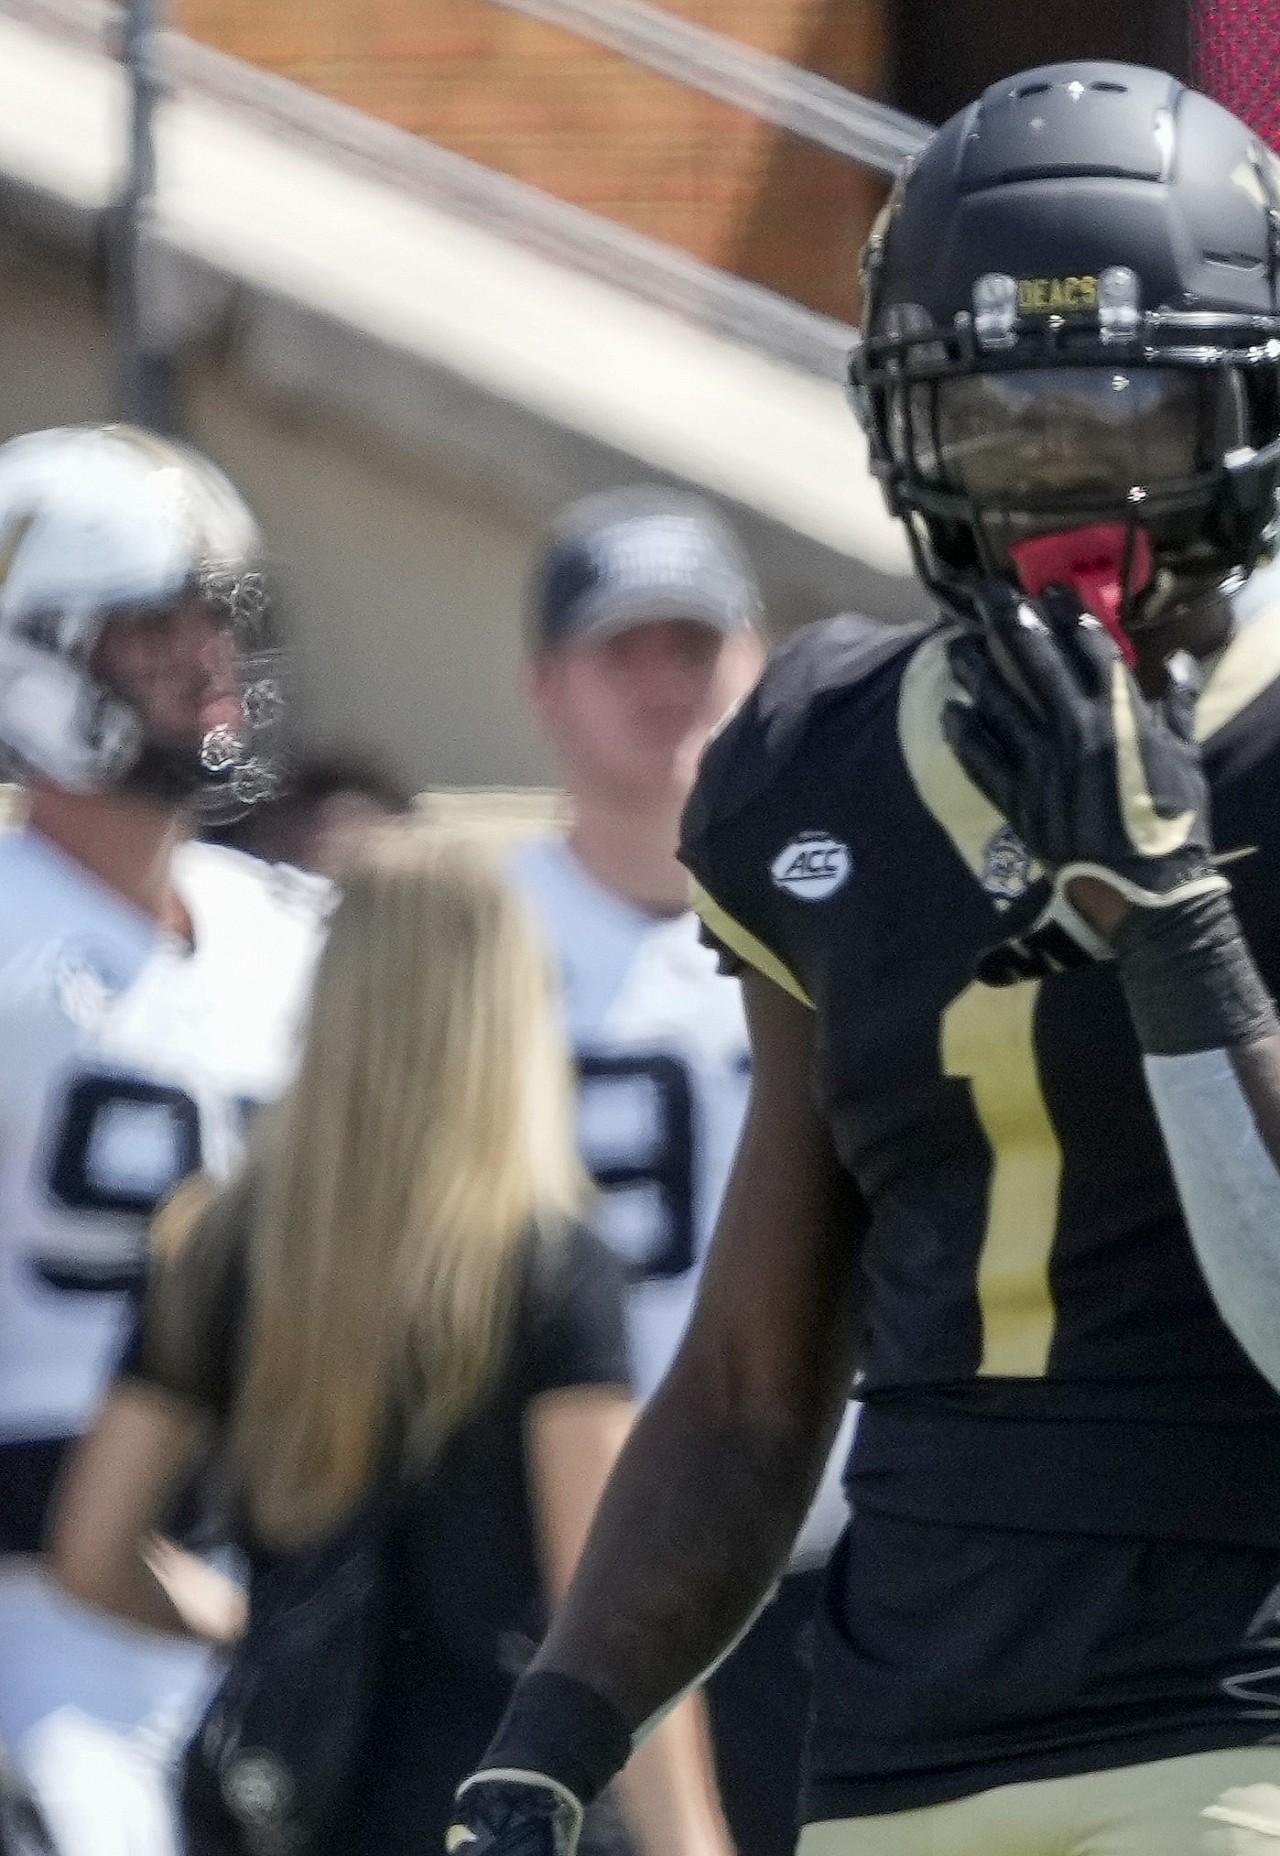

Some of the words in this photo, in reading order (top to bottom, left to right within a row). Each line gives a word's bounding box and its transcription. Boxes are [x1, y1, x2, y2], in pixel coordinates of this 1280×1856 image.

[1018, 276, 1097, 308] DEACS
[784, 847, 843, 877] ACC
[939, 976, 1063, 1379] 1
